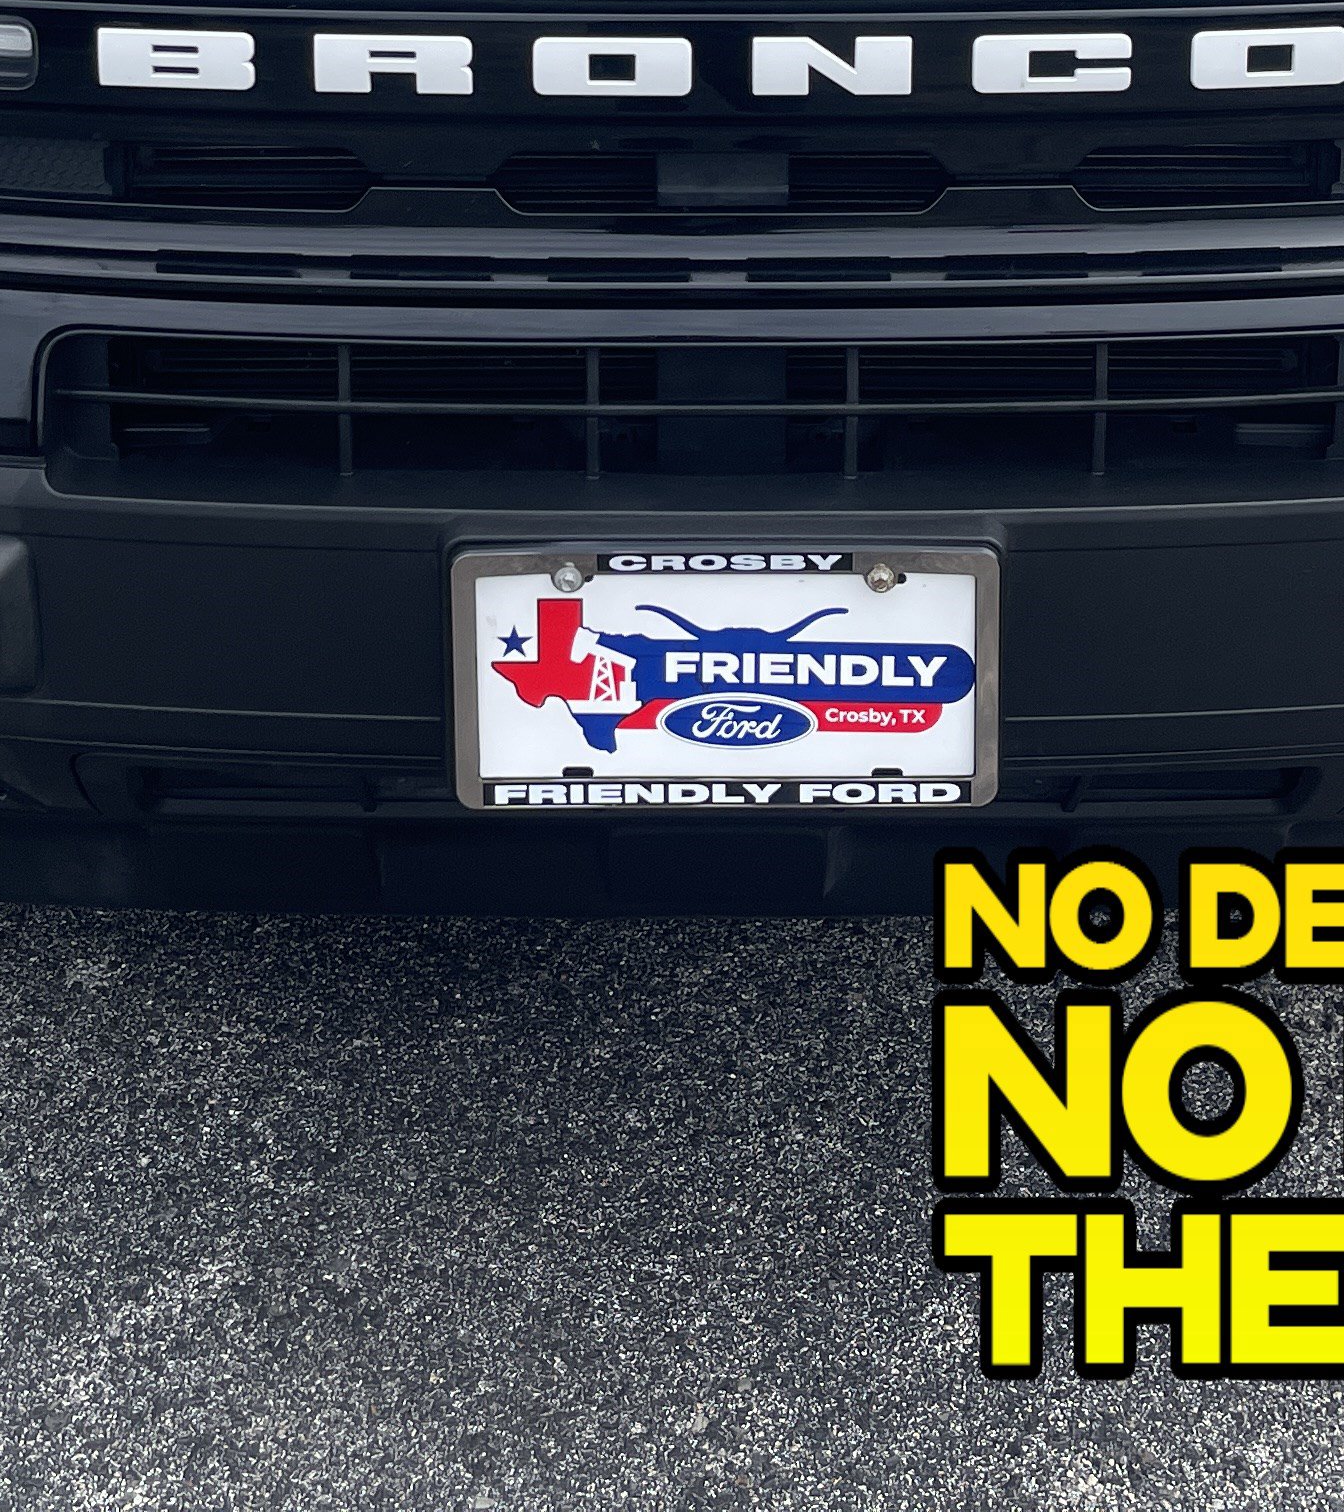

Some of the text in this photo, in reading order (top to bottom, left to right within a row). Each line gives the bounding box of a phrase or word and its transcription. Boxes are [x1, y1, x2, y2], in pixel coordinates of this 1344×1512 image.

[607, 553, 843, 573] CROSBY
[663, 651, 949, 688] FRIENDLY
[691, 702, 783, 740] Ford
[824, 707, 926, 727] Crosby, TX
[493, 782, 962, 806] FRIENDLY FORD
